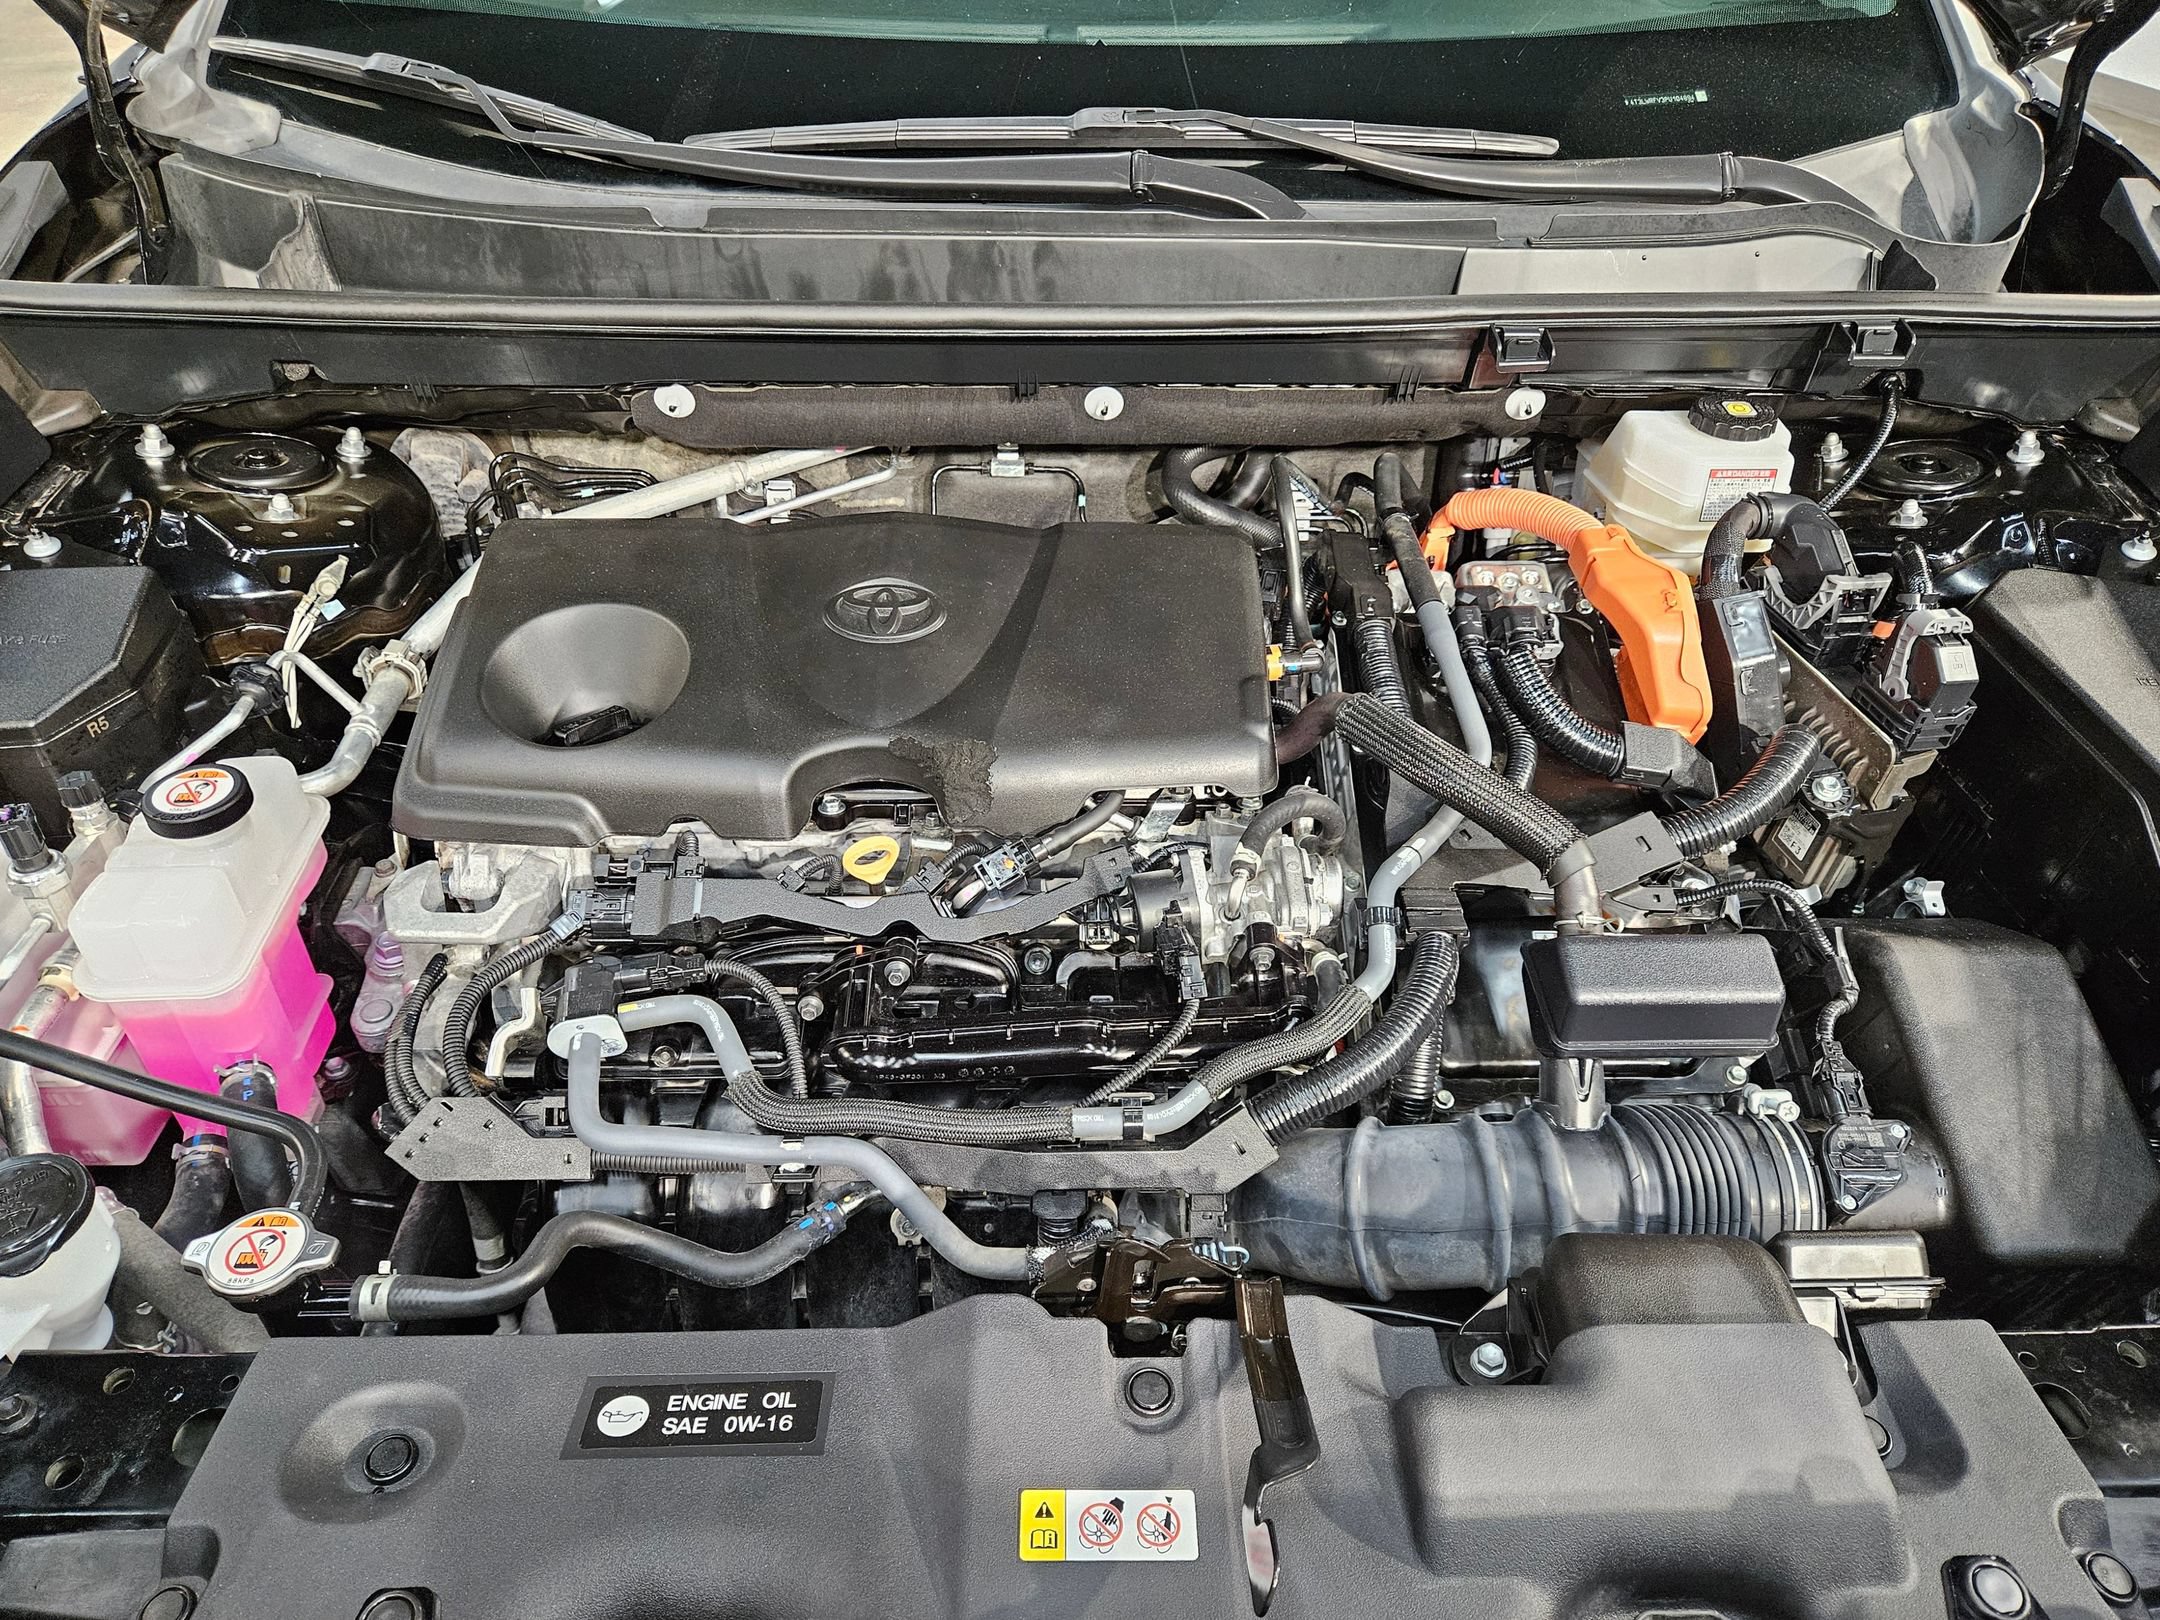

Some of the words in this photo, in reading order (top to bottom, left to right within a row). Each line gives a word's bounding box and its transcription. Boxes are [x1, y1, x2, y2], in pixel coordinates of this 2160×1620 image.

[87, 716, 110, 738] R5
[667, 1393, 749, 1412] ENGINE
[762, 1392, 798, 1409] OIL
[661, 1416, 708, 1435] SAE
[723, 1415, 793, 1433] 0W-16
